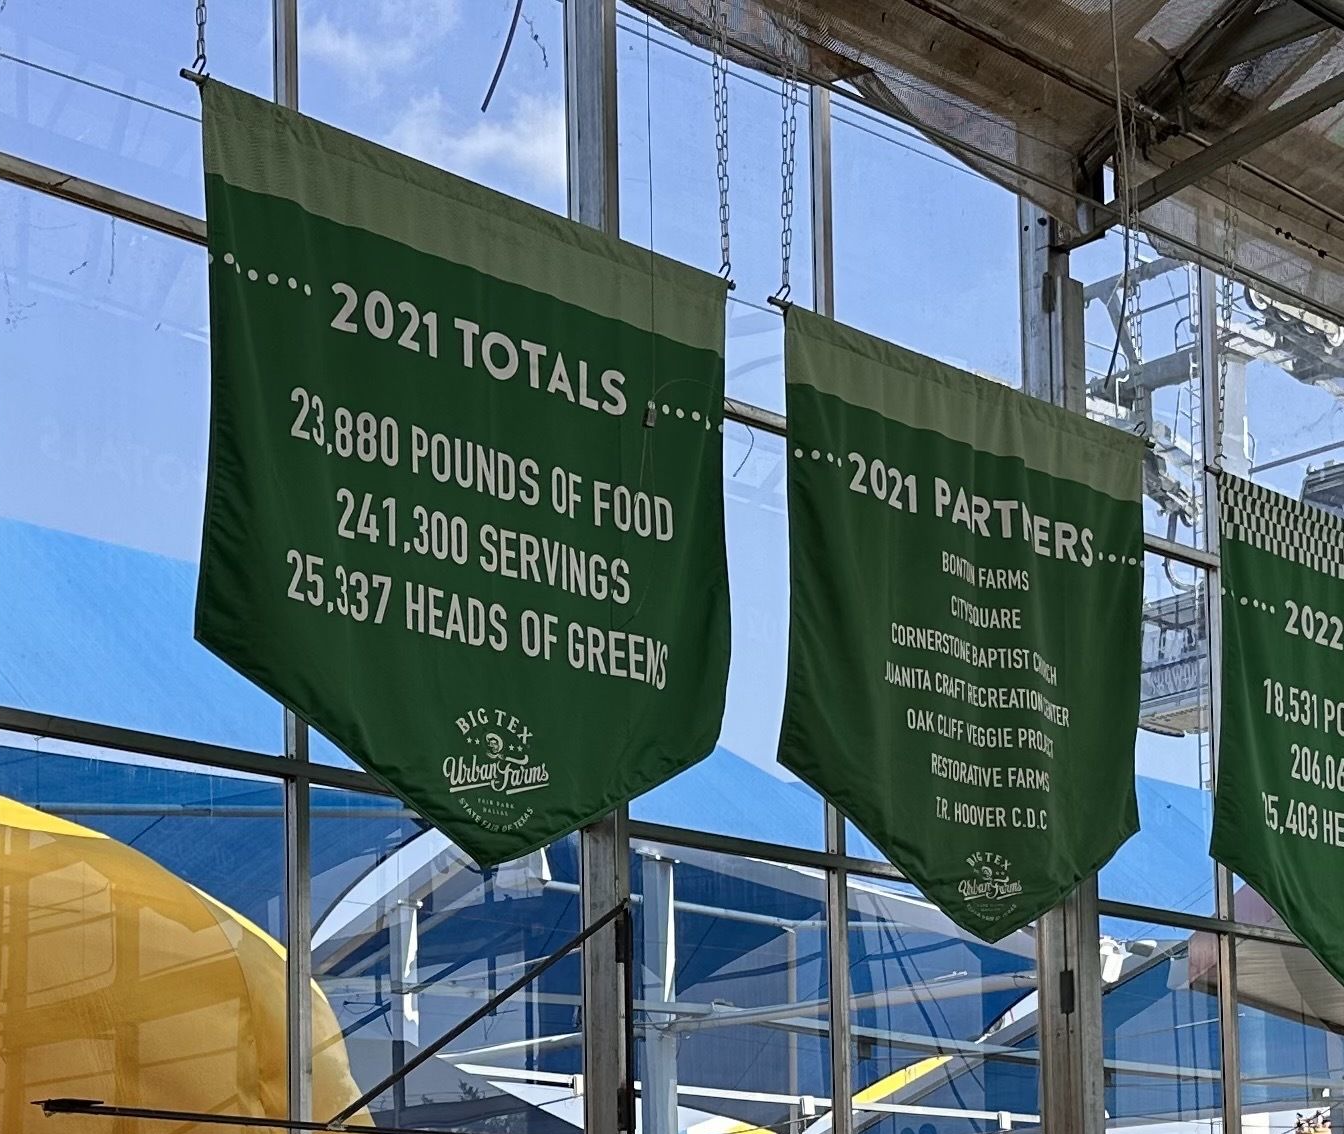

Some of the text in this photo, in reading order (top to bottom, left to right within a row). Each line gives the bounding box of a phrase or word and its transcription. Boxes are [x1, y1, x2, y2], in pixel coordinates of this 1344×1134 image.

[331, 282, 628, 416] 2021 TOTALS
[290, 386, 674, 542] 23,880 POUNDS OF FOOD
[848, 452, 1094, 567] 2021 PARTNERS
[336, 487, 631, 605] 241,300 SERVINGS
[942, 551, 1029, 591] BONTON FARMS
[286, 549, 669, 691] 25,337 HEADS OF GREENS
[950, 595, 1021, 629] CITYSQUARE
[1284, 600, 1344, 651] 2022
[891, 622, 971, 663] CORNERSTONE
[972, 645, 1029, 670] BAPTIST
[884, 660, 932, 691] JUANITA
[935, 672, 966, 701] CRAFT
[967, 682, 1043, 713] RECREATION
[1263, 678, 1318, 729] 18,531
[455, 708, 533, 744] BIG TEX
[906, 708, 1054, 759] OAK CLIFF VEGGIE PROJECT
[442, 754, 549, 791] Urban Farms
[931, 753, 1050, 792] RESTORATIVE FARMS
[458, 797, 482, 823] STATE
[513, 807, 534, 829] TEXAS
[954, 802, 1006, 828] HOOVER
[1012, 807, 1047, 830] C.D.C
[985, 852, 1012, 870] TEX
